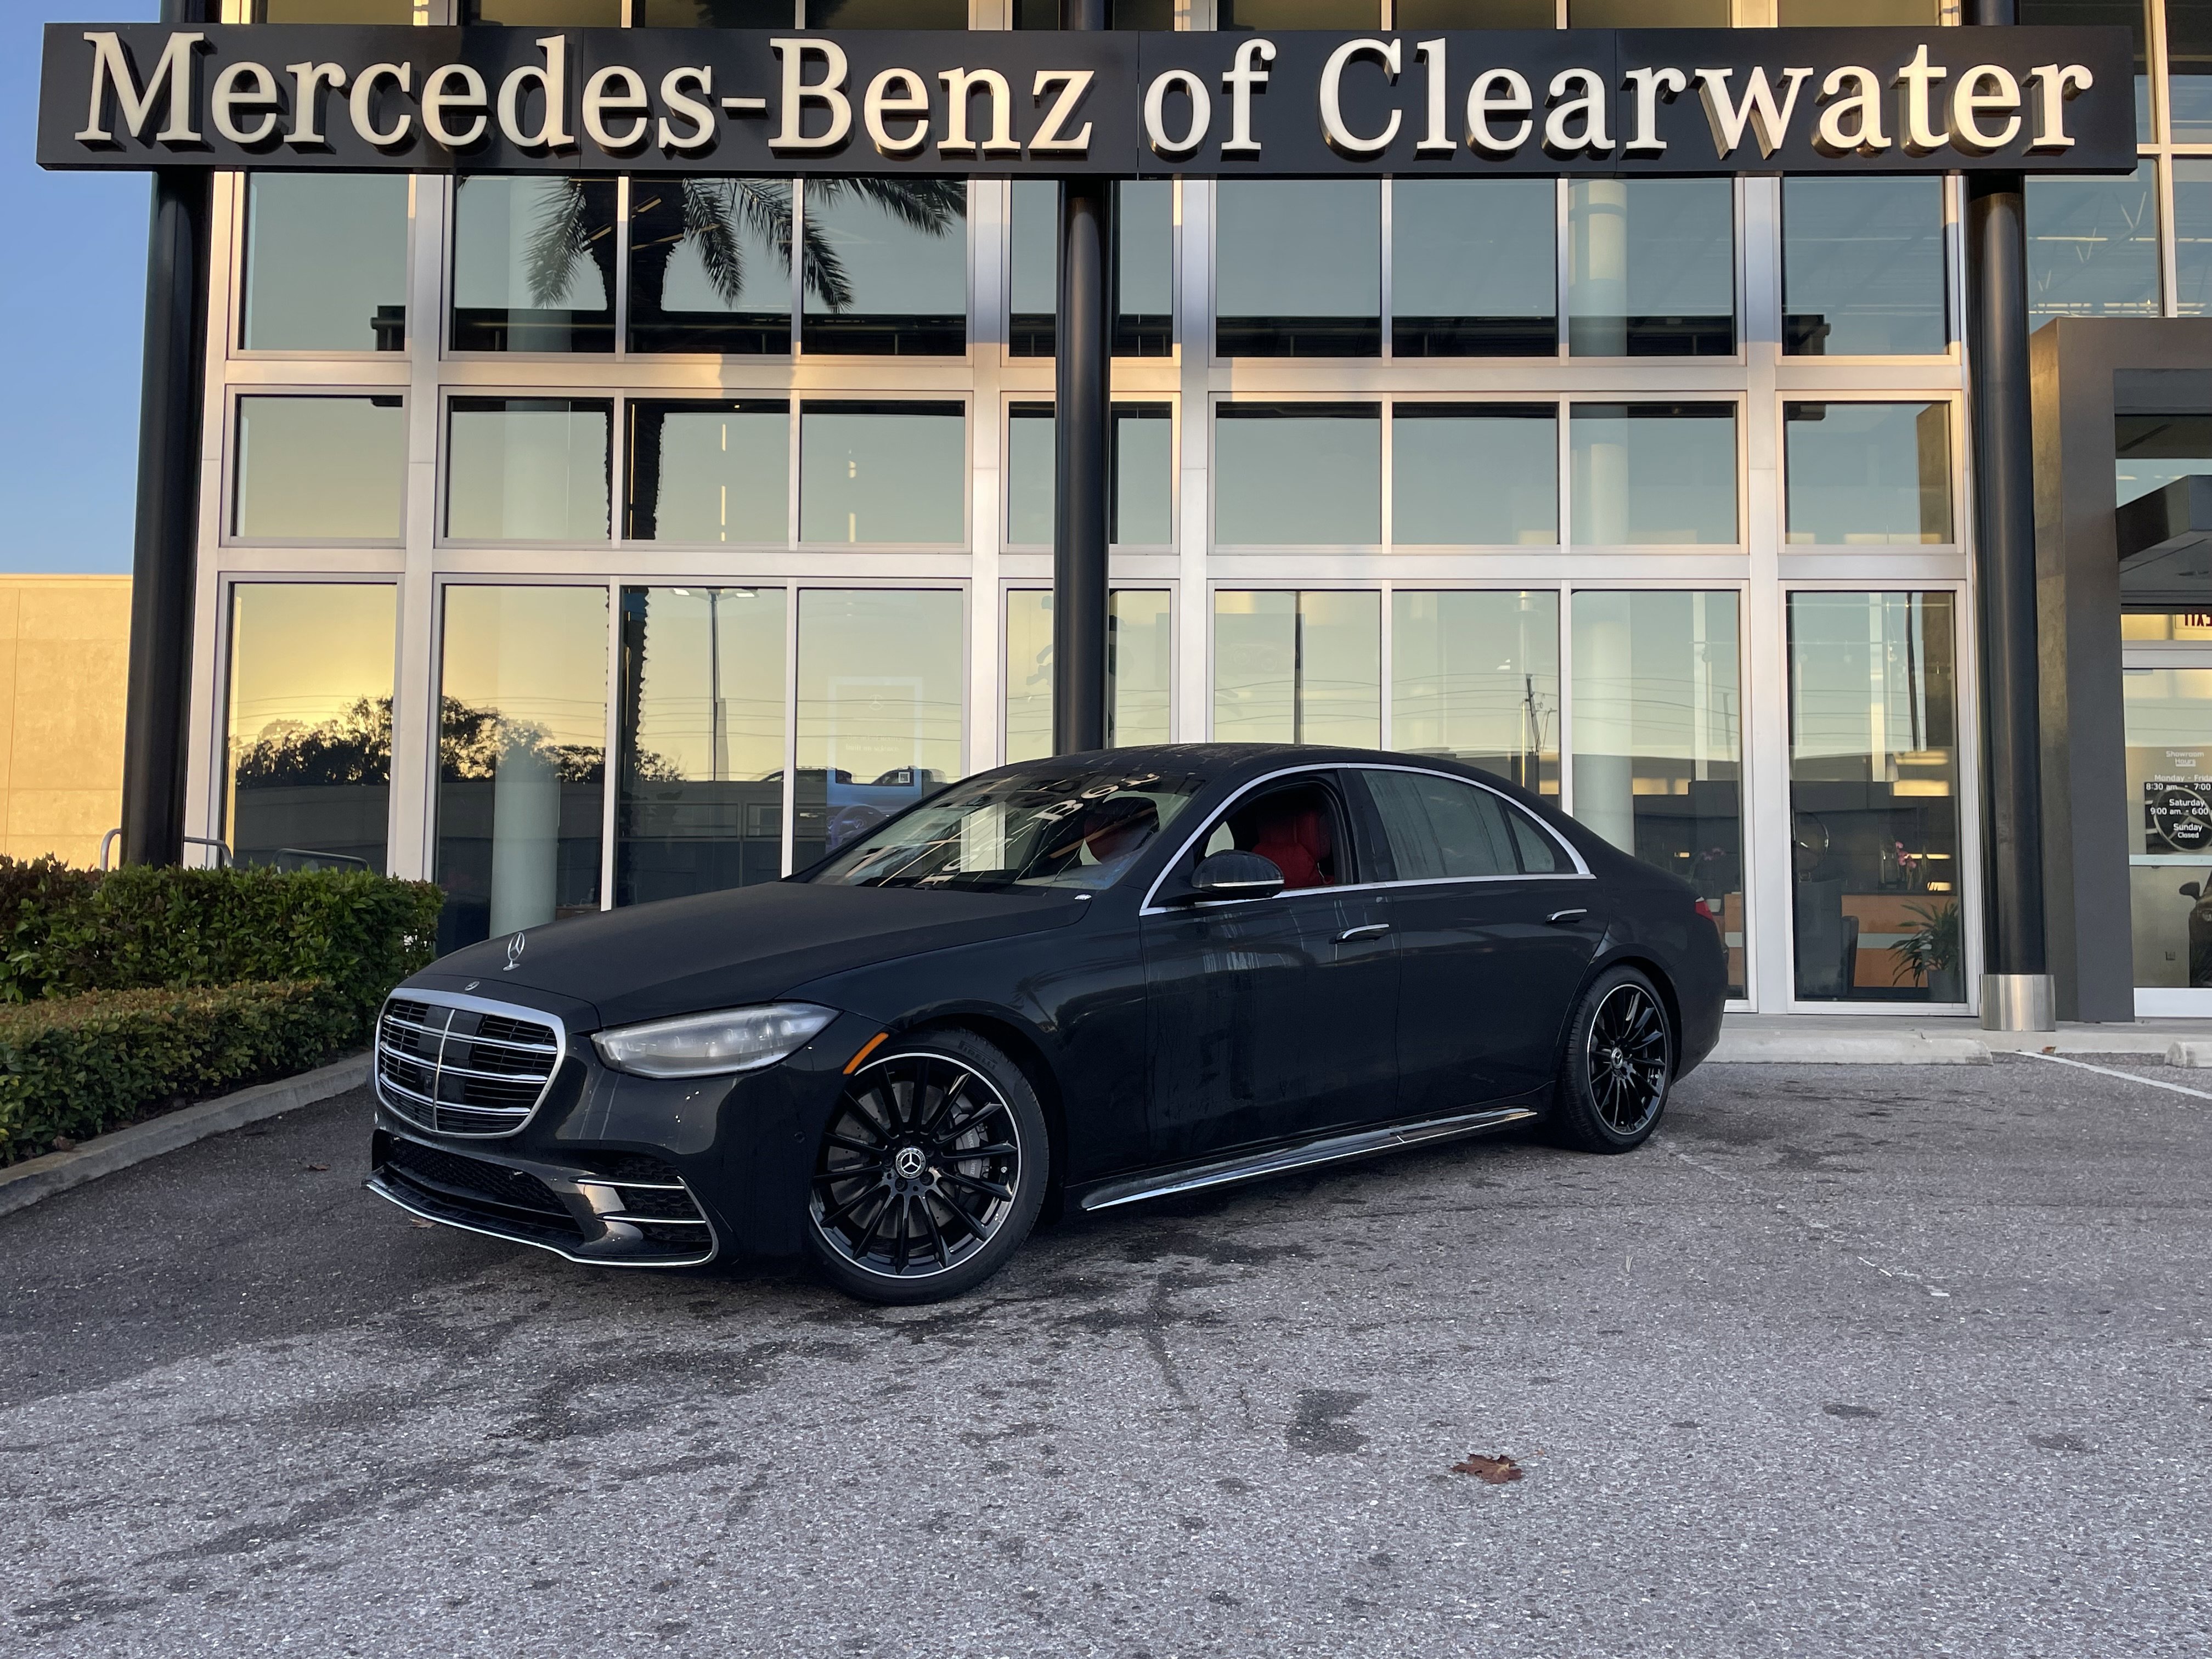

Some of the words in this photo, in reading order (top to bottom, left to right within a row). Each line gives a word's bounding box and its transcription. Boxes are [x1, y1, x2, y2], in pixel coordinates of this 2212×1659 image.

[75, 32, 1096, 154] Mercedes-Benz
[1144, 38, 1277, 152] of
[1319, 37, 2094, 152] Clearwater
[2169, 799, 2205, 808] Saturday
[2174, 823, 2203, 832] Sunday
